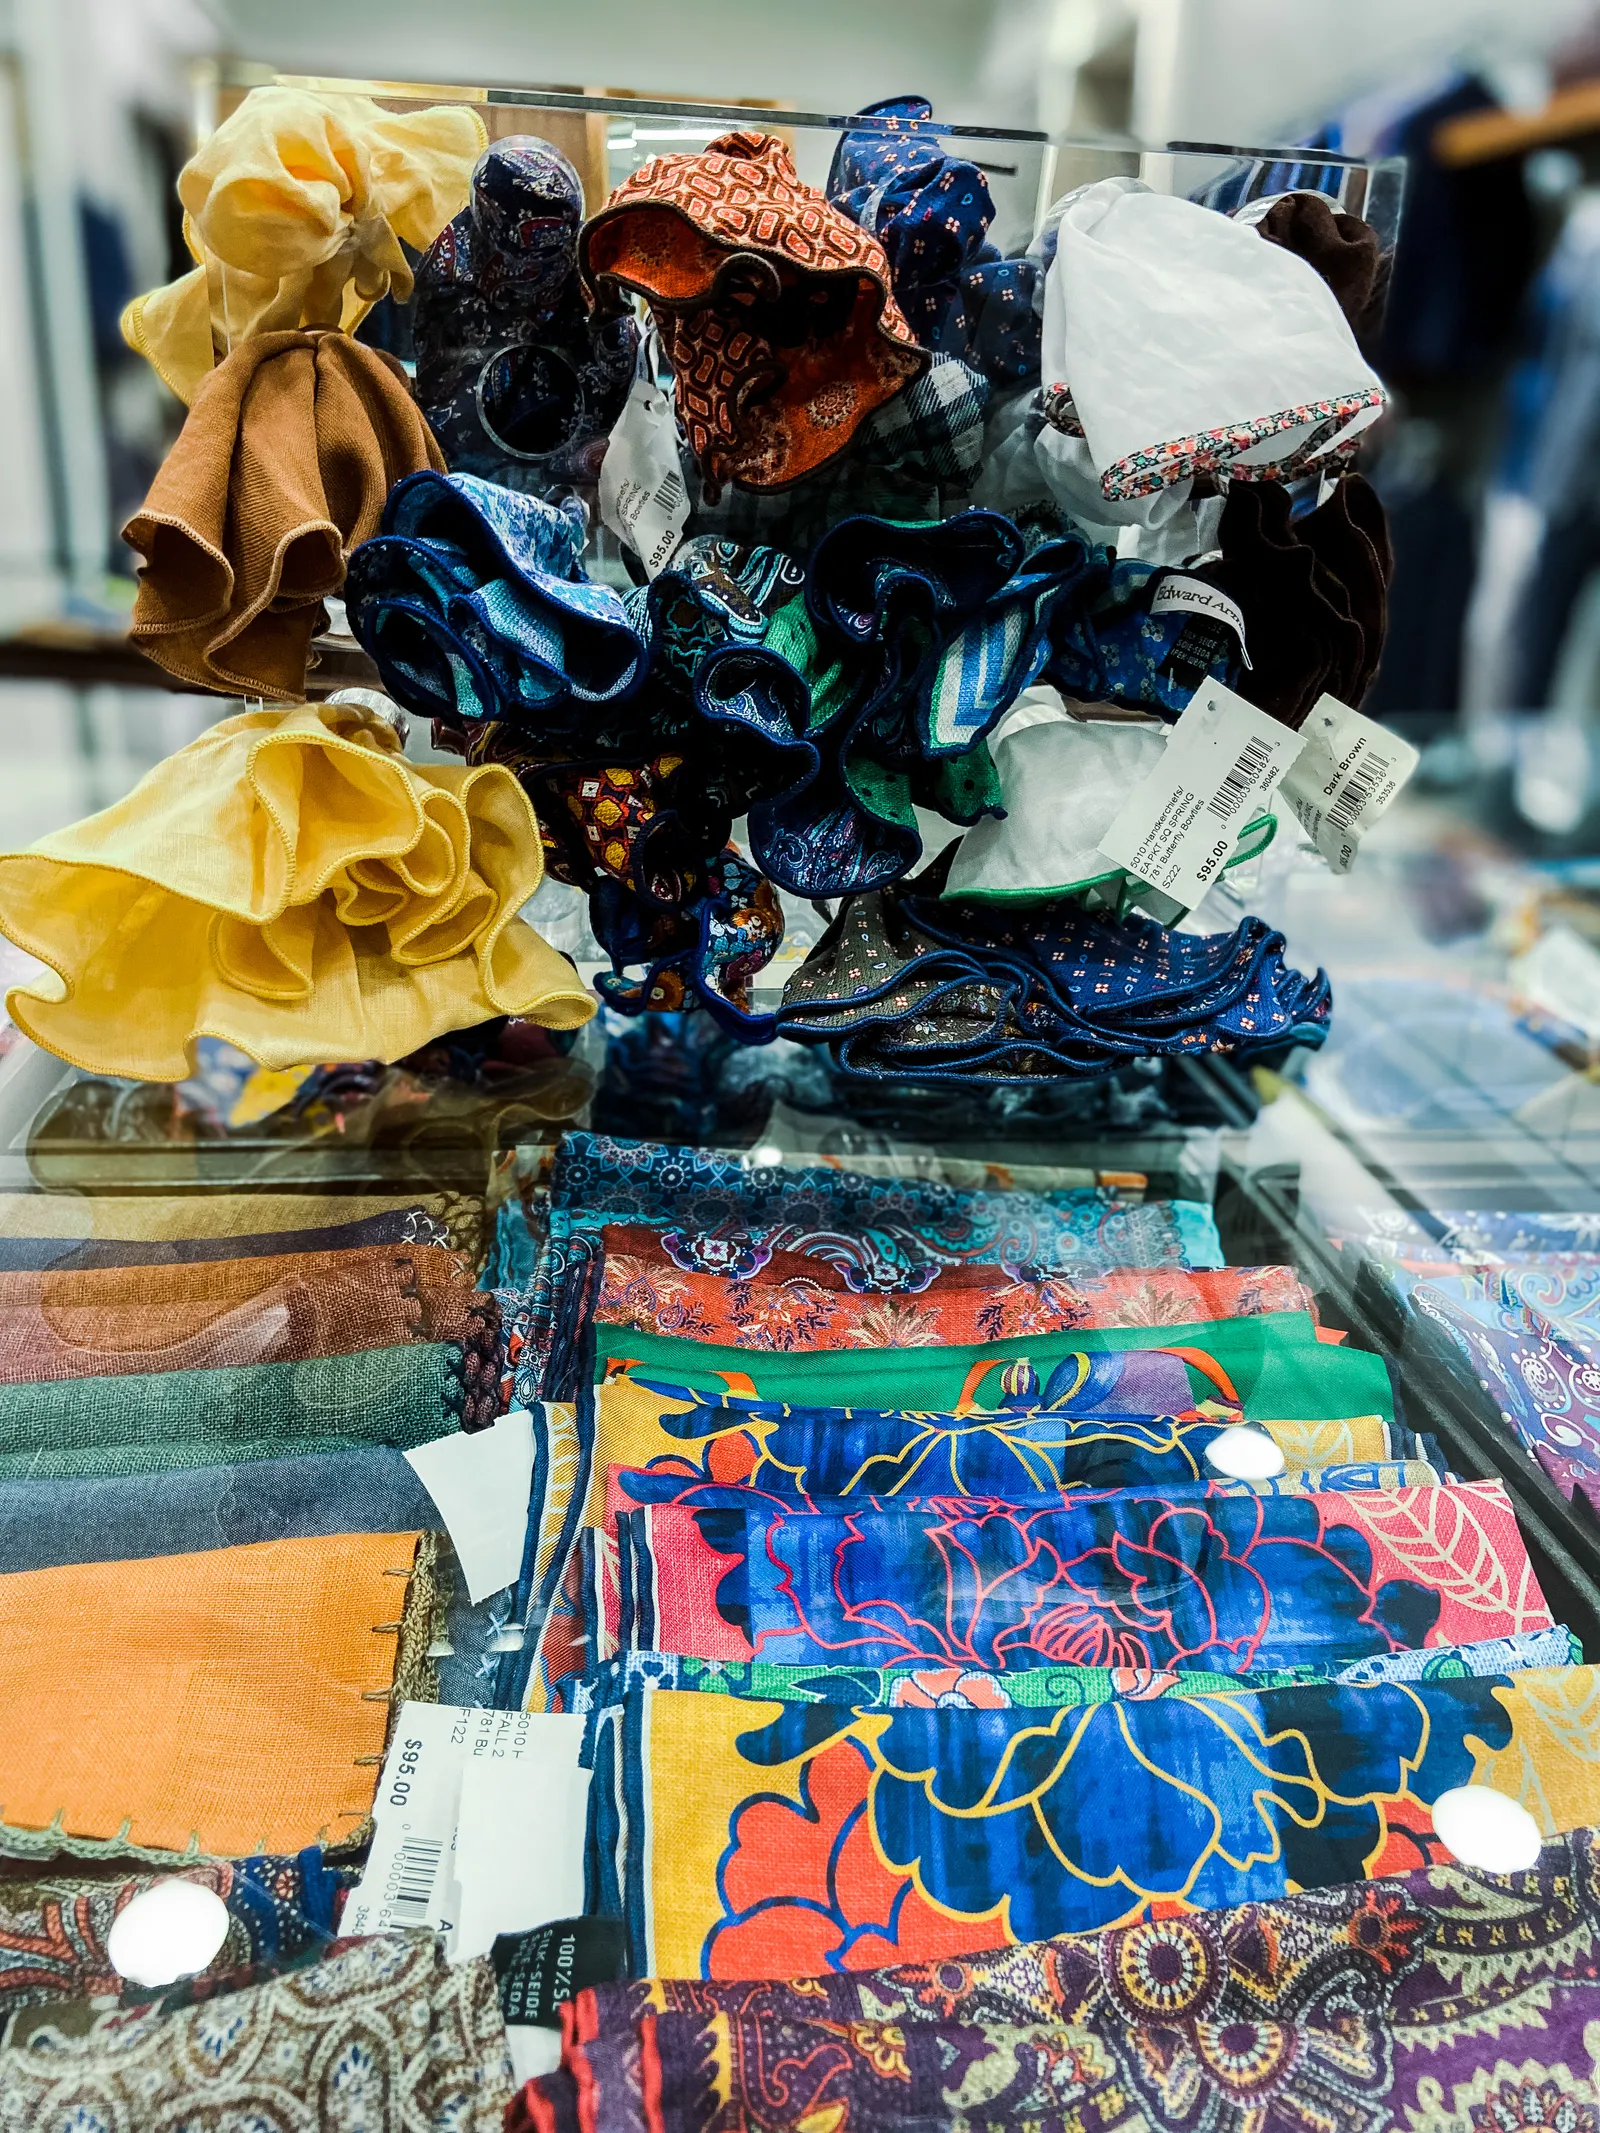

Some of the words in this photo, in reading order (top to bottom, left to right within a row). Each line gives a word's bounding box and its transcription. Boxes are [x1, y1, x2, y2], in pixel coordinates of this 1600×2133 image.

[649, 530, 675, 568] $95.00
[1157, 585, 1214, 606] Edward
[1230, 787, 1252, 815] 00003
[1249, 756, 1271, 787] 60482
[1259, 765, 1281, 792] 360482
[1323, 770, 1344, 797] Dark
[1339, 736, 1367, 772] Brown
[1376, 780, 1397, 805] 353536
[1130, 846, 1148, 869] 5010
[1144, 785, 1184, 847] Handkerchiefs/
[1139, 859, 1152, 875] EA
[1148, 842, 1162, 862] PKT
[1159, 827, 1173, 843] SQ
[1169, 792, 1195, 828] SPRING
[1149, 862, 1164, 881] 781
[1160, 831, 1185, 864] Butterfly
[1182, 799, 1205, 831] Bowties
[1162, 864, 1182, 889] S222
[1196, 840, 1228, 882] $95.00
[450, 1707, 471, 1744] F122
[477, 1709, 496, 1736] 781
[491, 1711, 514, 1746] FALL
[513, 1712, 531, 1746] 5010
[389, 1738, 424, 1807] $95.00
[383, 1851, 407, 1902] 00003
[352, 1904, 370, 1936] 3640
[525, 1929, 554, 2019] SILK-SEIDE
